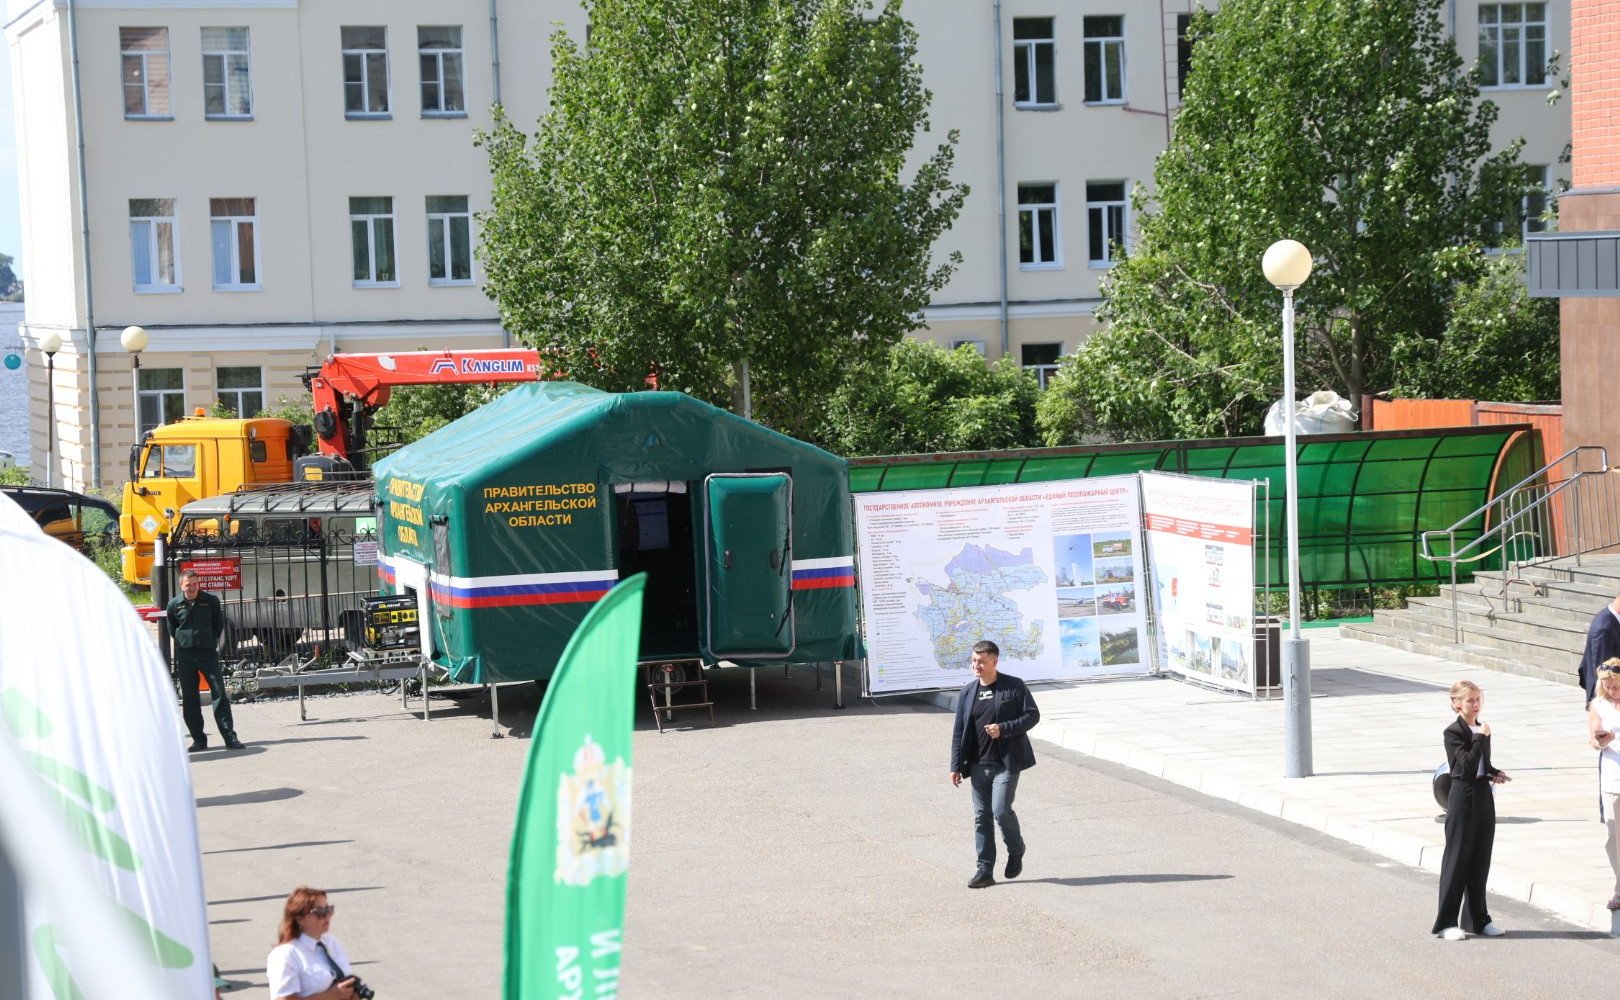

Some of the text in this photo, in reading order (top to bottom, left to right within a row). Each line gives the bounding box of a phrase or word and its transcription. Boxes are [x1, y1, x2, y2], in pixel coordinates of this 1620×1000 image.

[462, 358, 524, 373] KANGLIM
[484, 483, 595, 498] ПРАВИТЕЛЬСТВО
[485, 496, 596, 513] АРХАНГЕЛЬСКОЙ
[864, 502, 910, 511] ГОСУДАРСТВЕННОЕ
[911, 501, 943, 509] АВТОНОМНОЕ
[944, 498, 976, 507] УЧРЕЖДЕНИЕ
[978, 495, 1018, 505] АРХАНГЕЛЬСКОЙ
[1019, 493, 1041, 501] ОБЛАСТИ
[1068, 489, 1109, 498] ЛЕСОПОЖАРНЫЙ
[509, 514, 571, 527] ОБЛАСТИ
